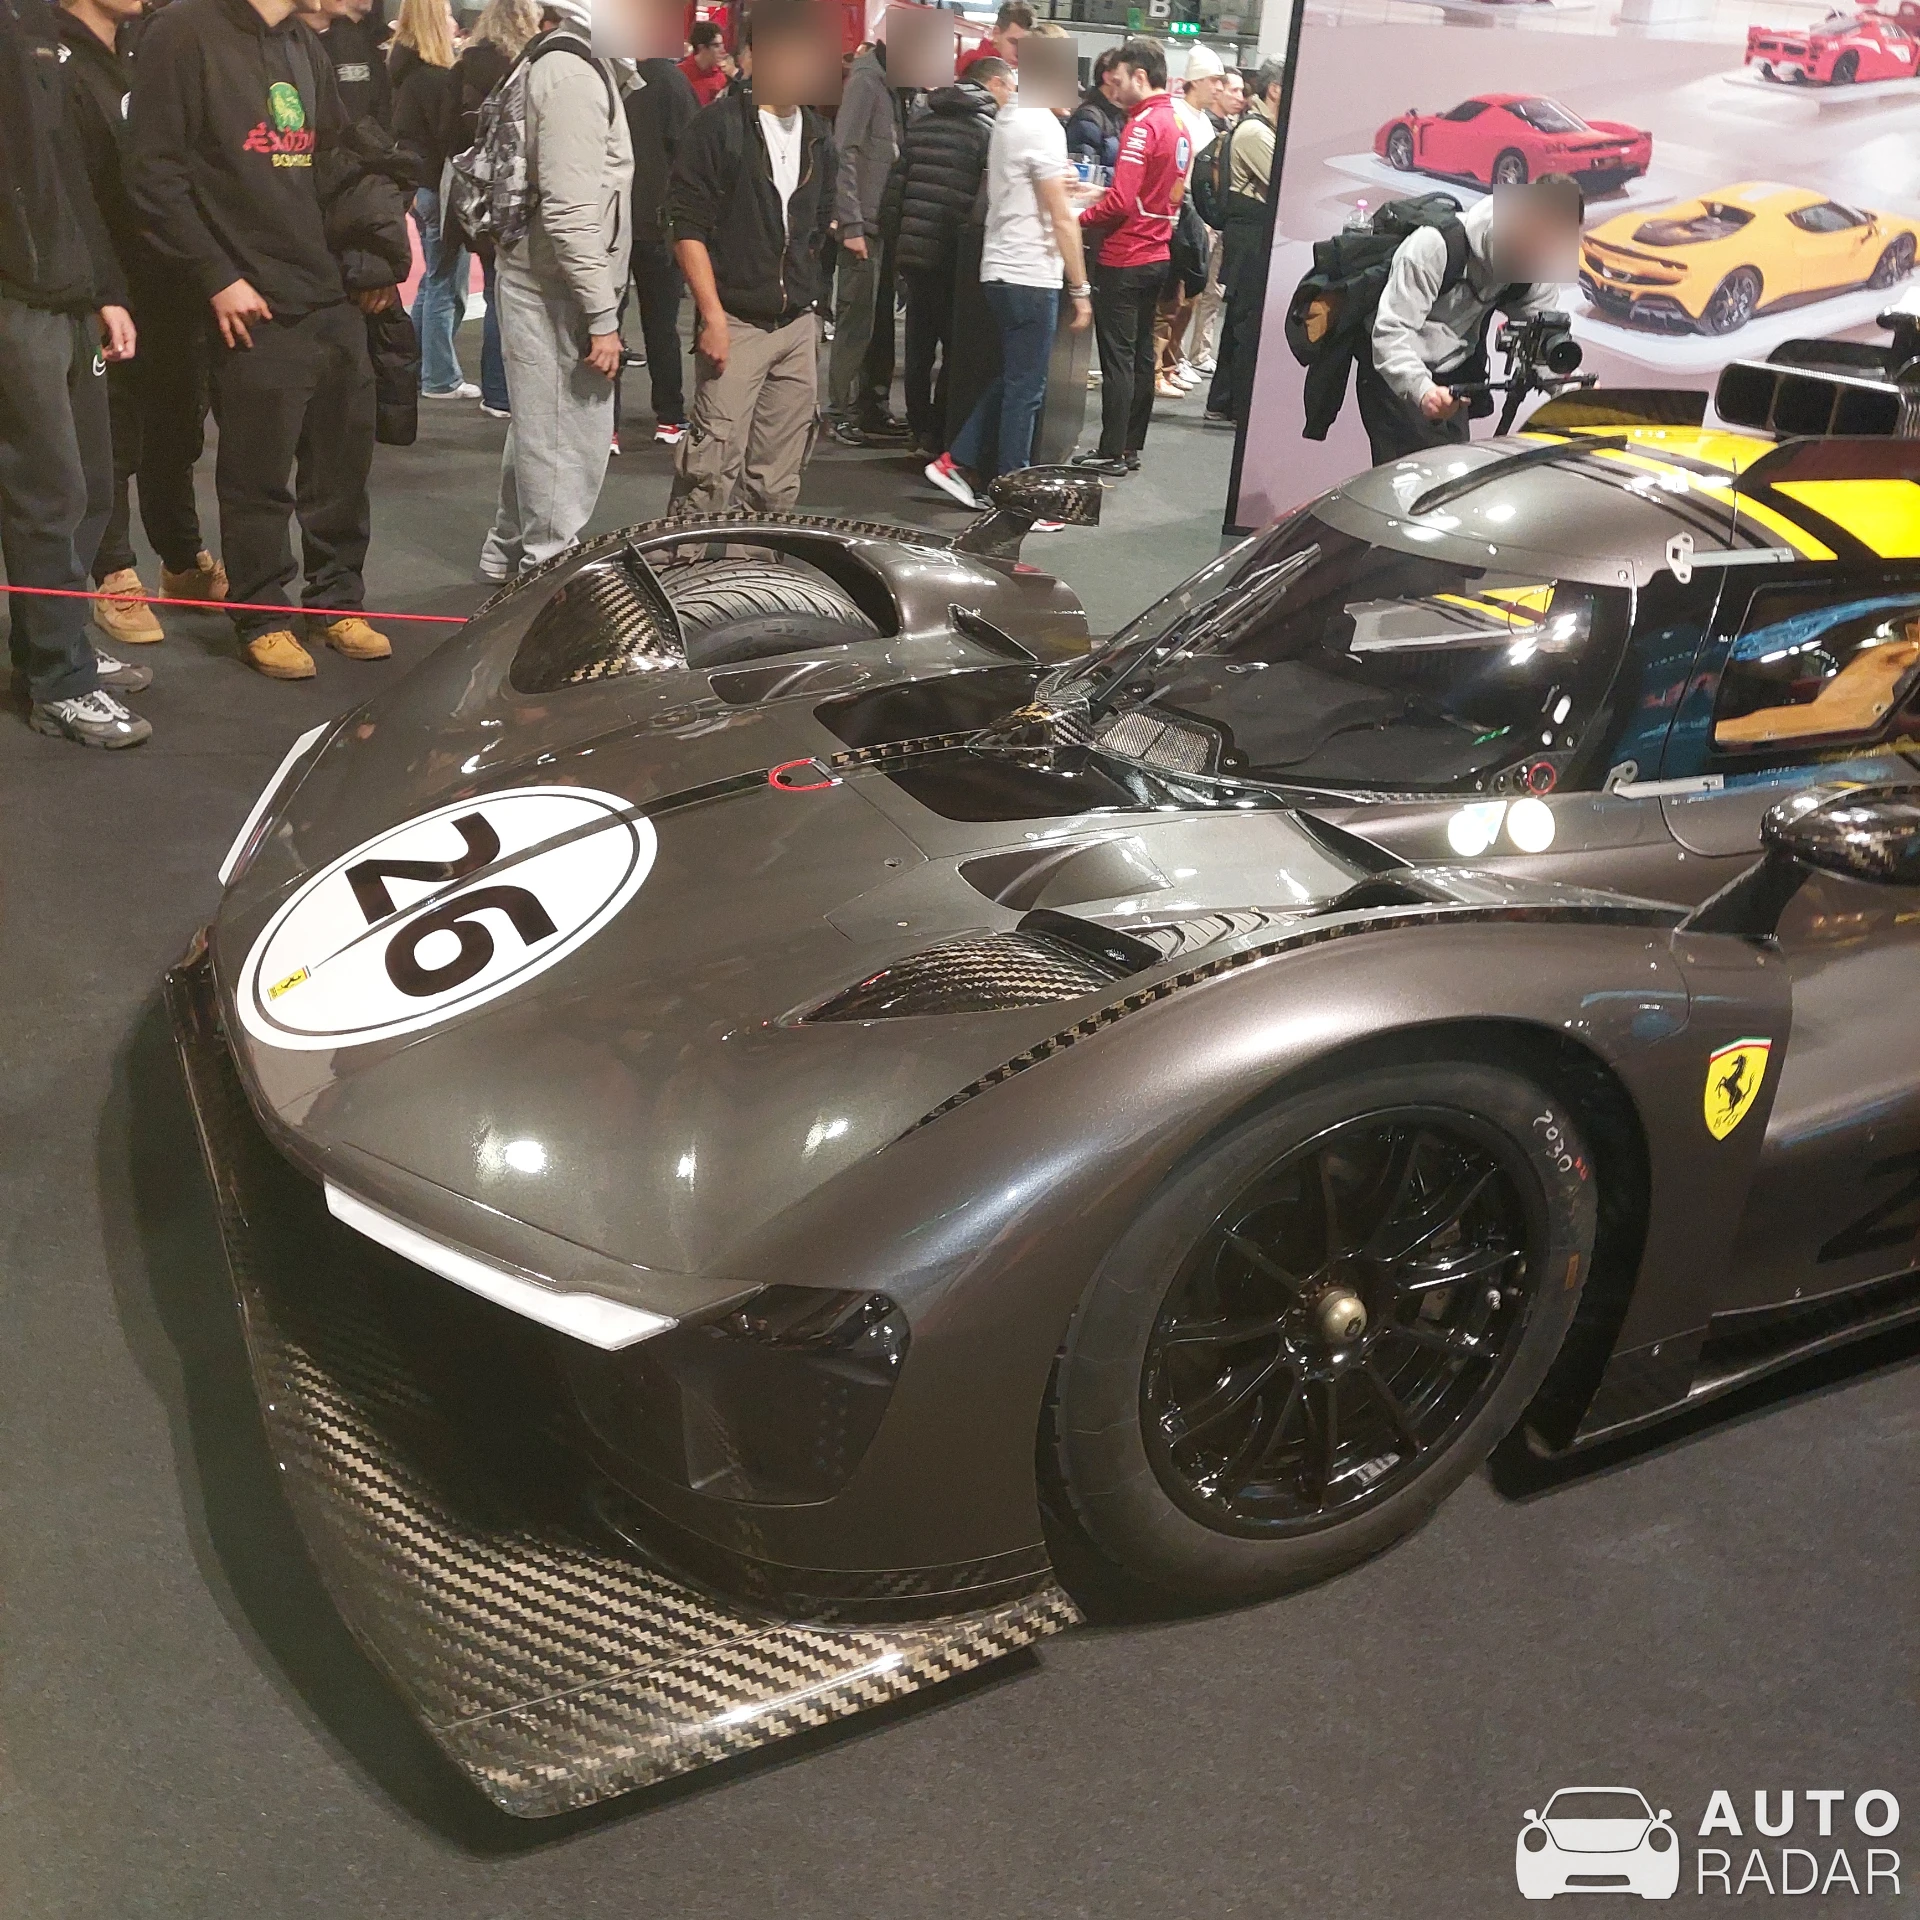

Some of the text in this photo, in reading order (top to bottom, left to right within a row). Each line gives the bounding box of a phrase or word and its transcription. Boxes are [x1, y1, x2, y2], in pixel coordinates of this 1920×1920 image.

[1149, 0, 1171, 17] B
[345, 812, 558, 997] 26
[1533, 1109, 1573, 1172] 2030
